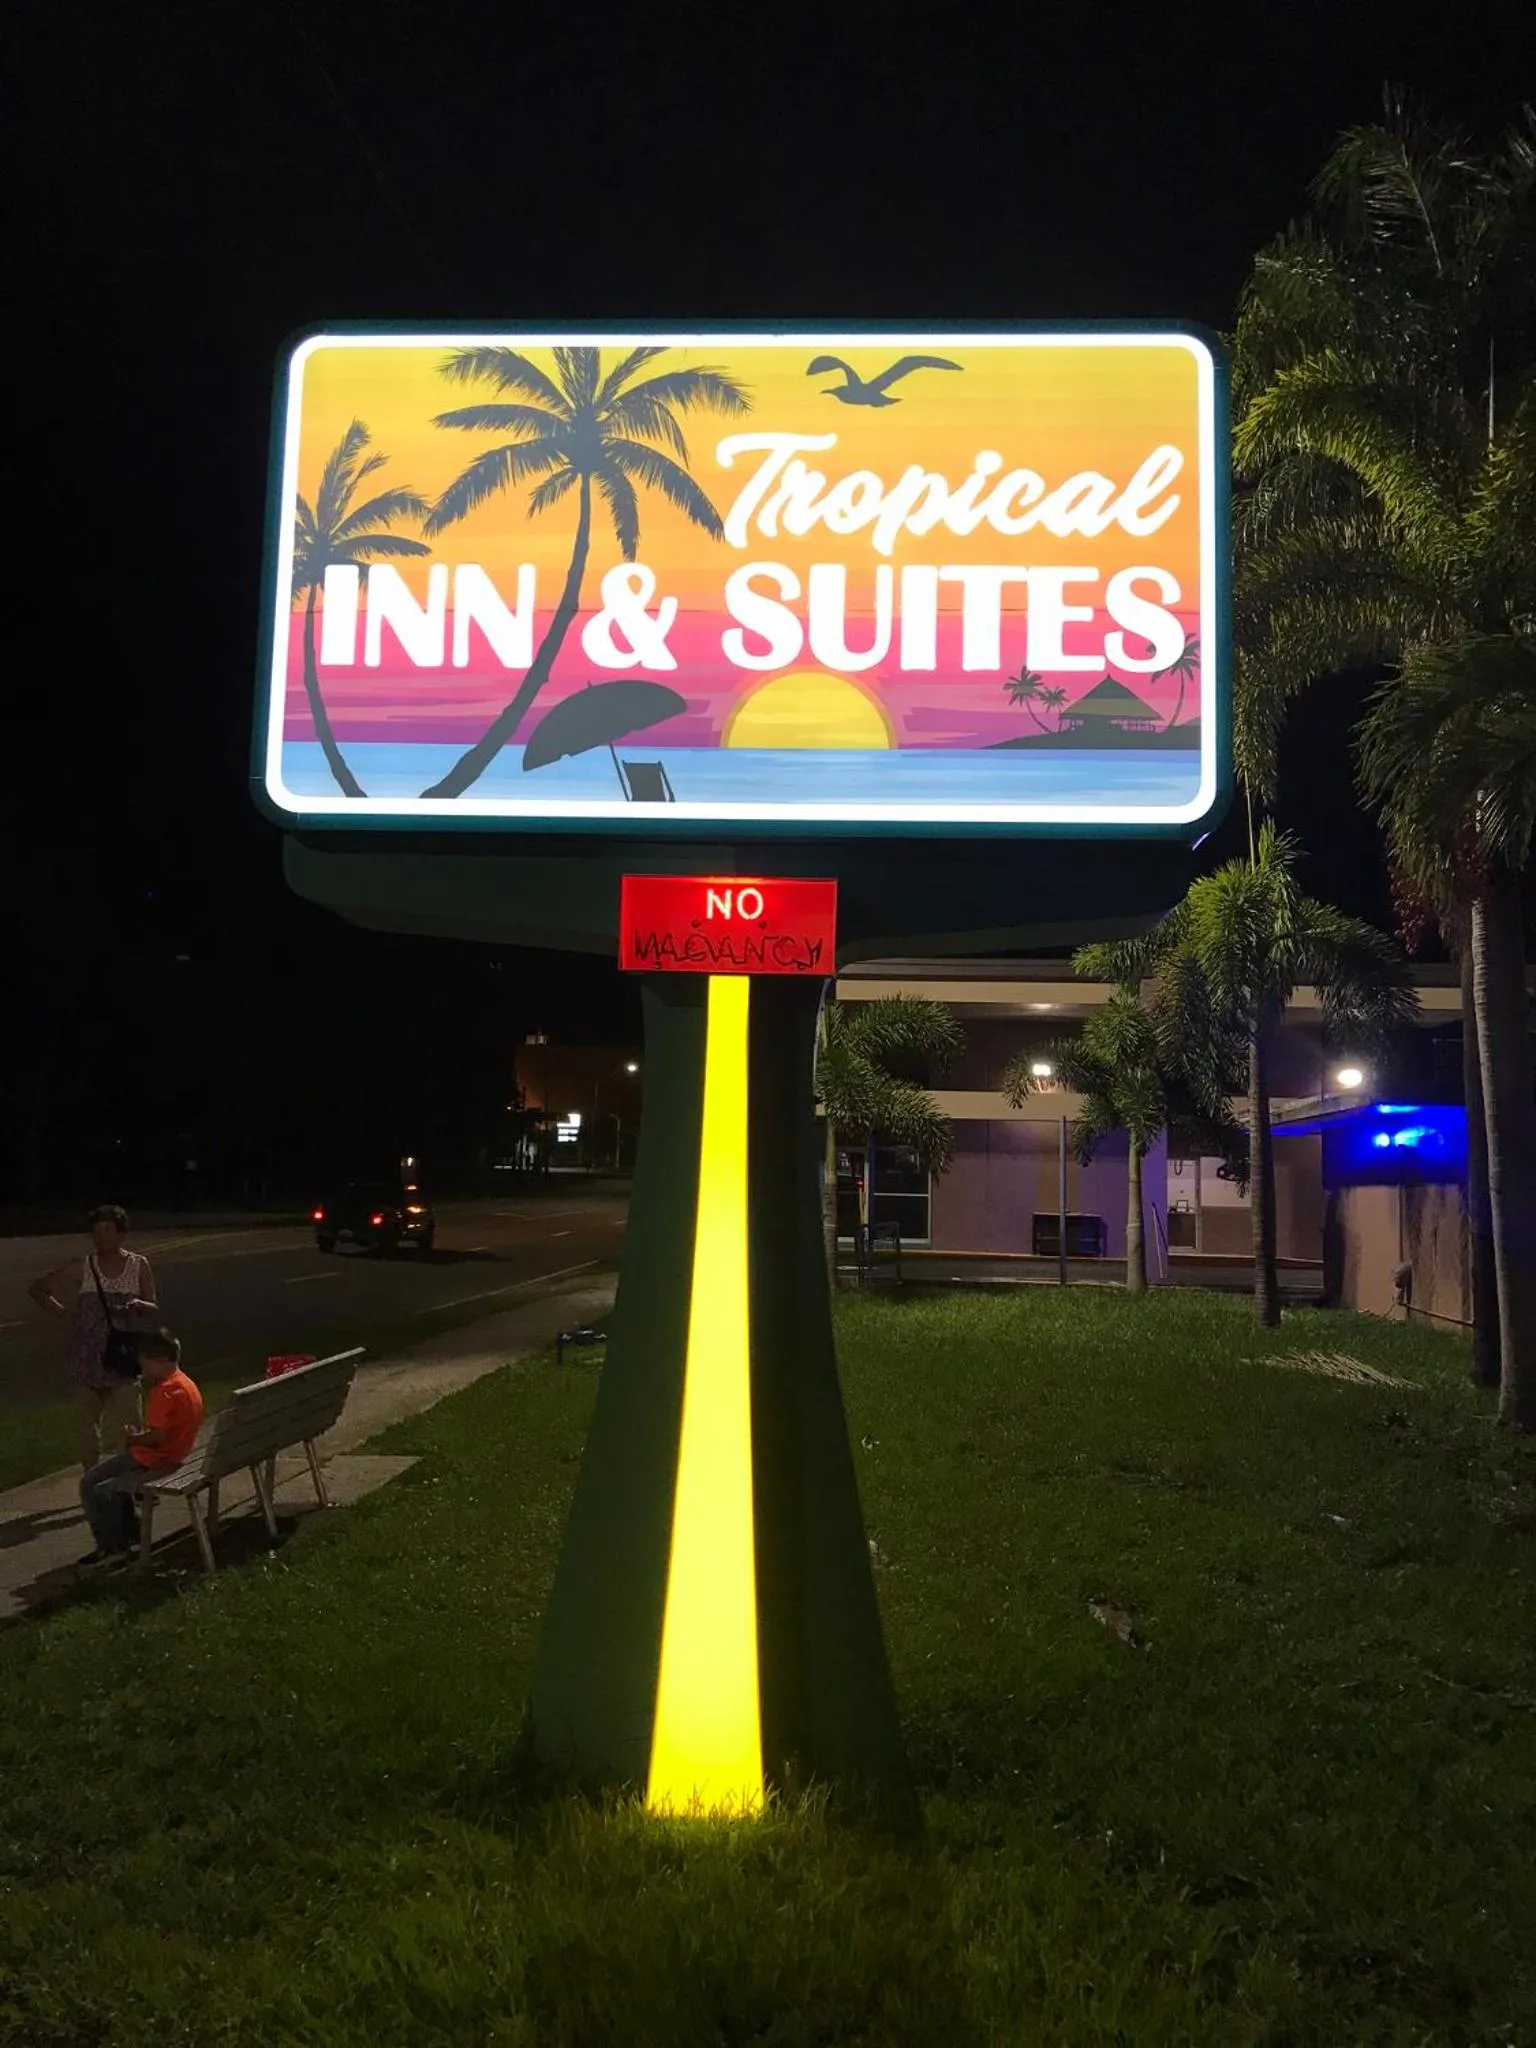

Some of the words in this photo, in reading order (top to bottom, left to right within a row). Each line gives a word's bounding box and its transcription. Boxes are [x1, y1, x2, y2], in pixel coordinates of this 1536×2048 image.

[717, 434, 1183, 555] Tropical
[320, 564, 536, 669] INN
[582, 563, 677, 670] &
[722, 563, 1185, 672] SUITES
[707, 888, 764, 920] NO
